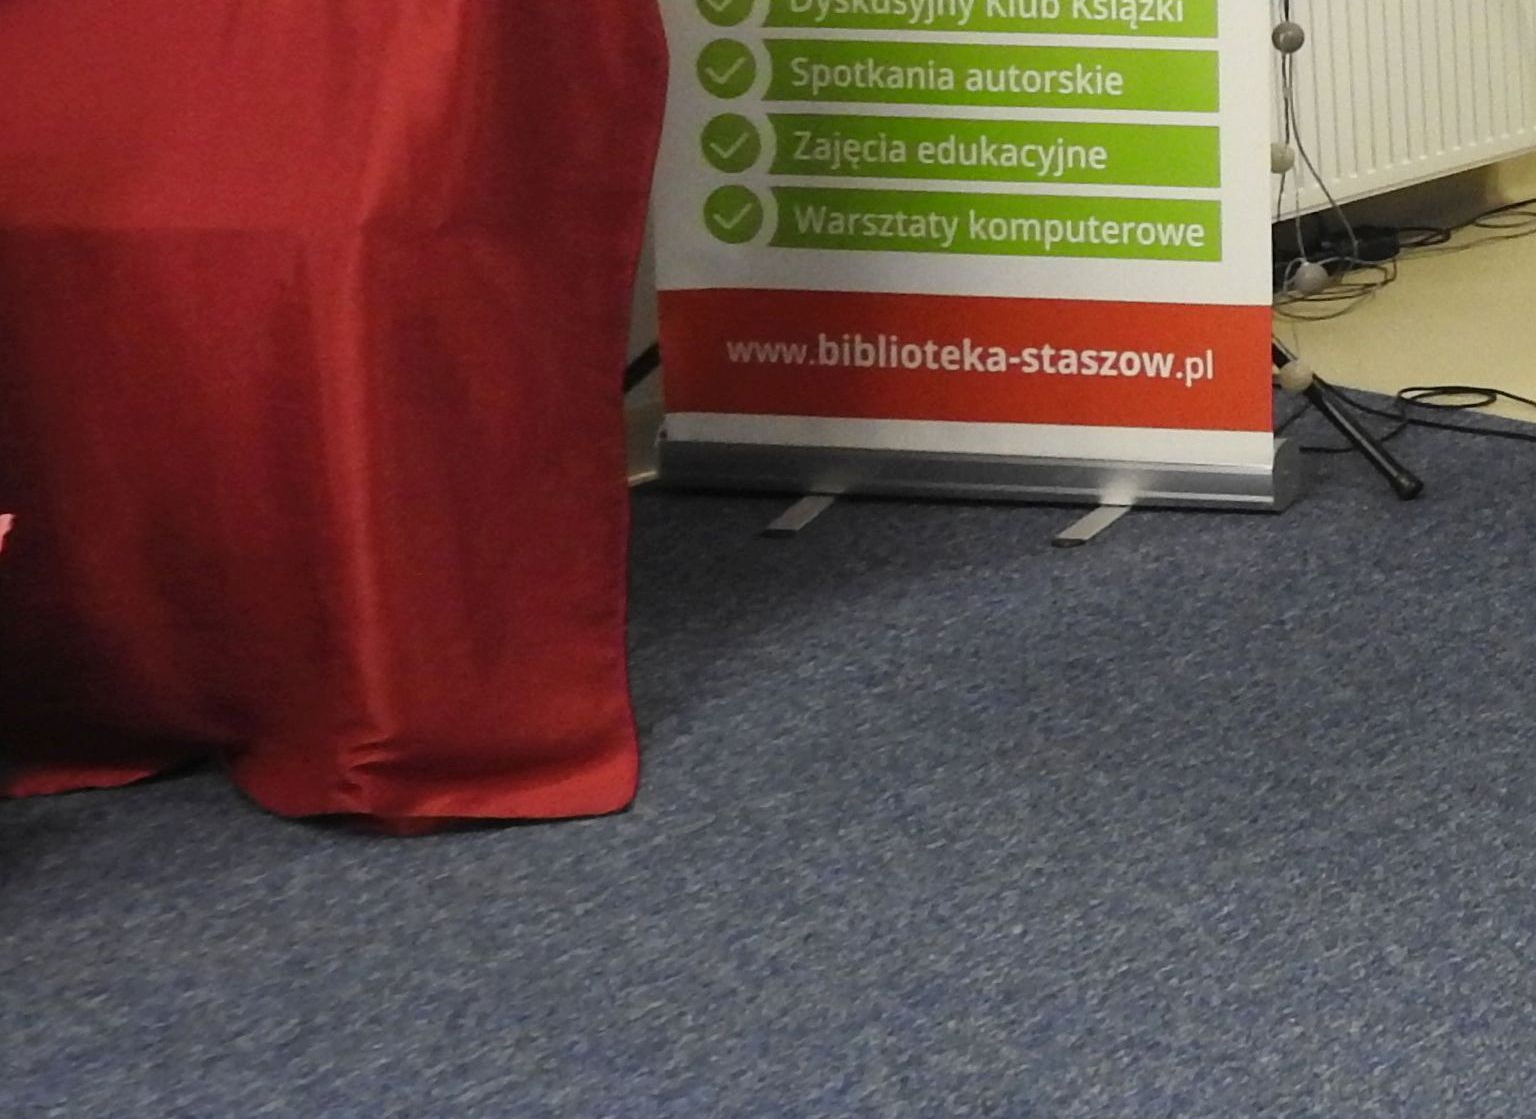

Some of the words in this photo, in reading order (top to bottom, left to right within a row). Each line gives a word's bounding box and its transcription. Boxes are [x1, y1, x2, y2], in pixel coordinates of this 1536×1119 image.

[791, 55, 956, 100] Spotkania
[965, 60, 1124, 98] autorskie
[792, 130, 908, 174] Zajęcia
[918, 135, 1109, 177] edukacyjne
[796, 203, 959, 248] Warsztaty
[968, 208, 1206, 251] komputerowe
[727, 332, 1215, 386] www.biblioteka-staszow.pl
